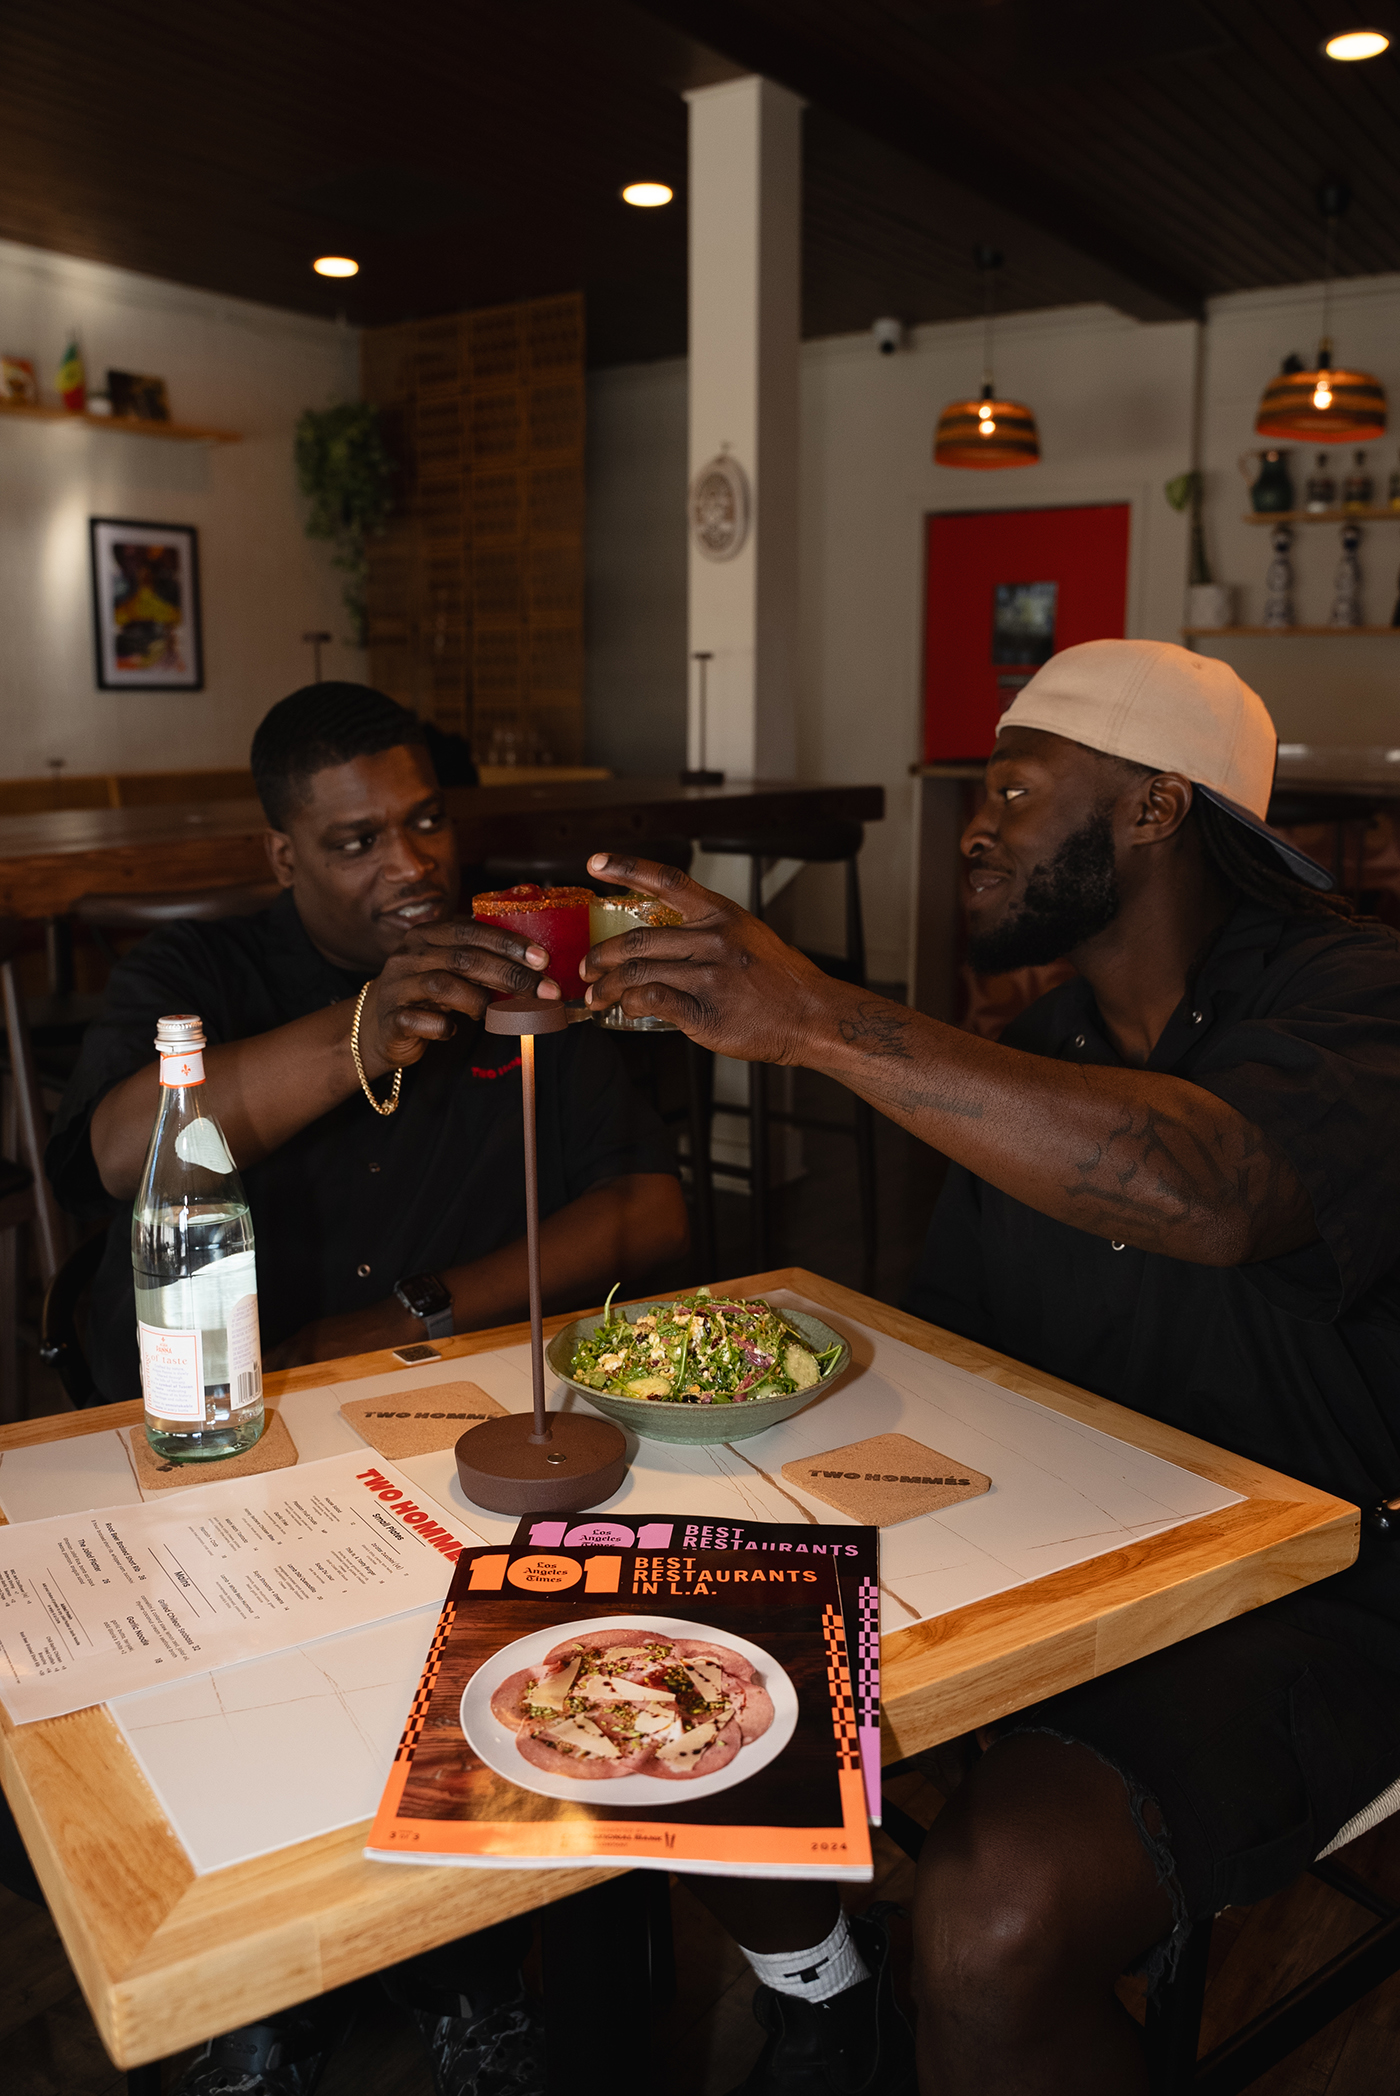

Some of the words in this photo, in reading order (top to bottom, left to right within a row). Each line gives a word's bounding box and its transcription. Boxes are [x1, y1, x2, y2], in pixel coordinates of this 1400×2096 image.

[150, 1354, 159, 1362] of
[162, 1356, 188, 1365] taste
[414, 1412, 499, 1420] HOMM
[808, 1469, 861, 1480] TWO
[864, 1473, 971, 1486] HOMMÉS
[356, 1468, 404, 1502] TWO
[372, 1513, 391, 1527] Small
[386, 1526, 404, 1540] Plates
[684, 1524, 744, 1538] BEST
[78, 1539, 86, 1547] The
[682, 1536, 858, 1556] RESTAURANTS
[635, 1557, 696, 1570] BEST
[174, 1570, 190, 1587] Mains
[468, 1554, 622, 1594] 101
[523, 1568, 568, 1576] Angeles
[633, 1570, 818, 1582] RESTAURANTS
[526, 1575, 562, 1583] Times
[632, 1582, 658, 1594] IN
[670, 1582, 718, 1595] L.A.
[158, 1600, 172, 1613] Grilled
[167, 1612, 181, 1629] Chilean
[178, 1628, 194, 1645] Seabass
[126, 1616, 139, 1630] Garlic
[135, 1630, 149, 1646] Noodle
[390, 1830, 396, 1838] 3
[810, 1842, 848, 1850] 2024
